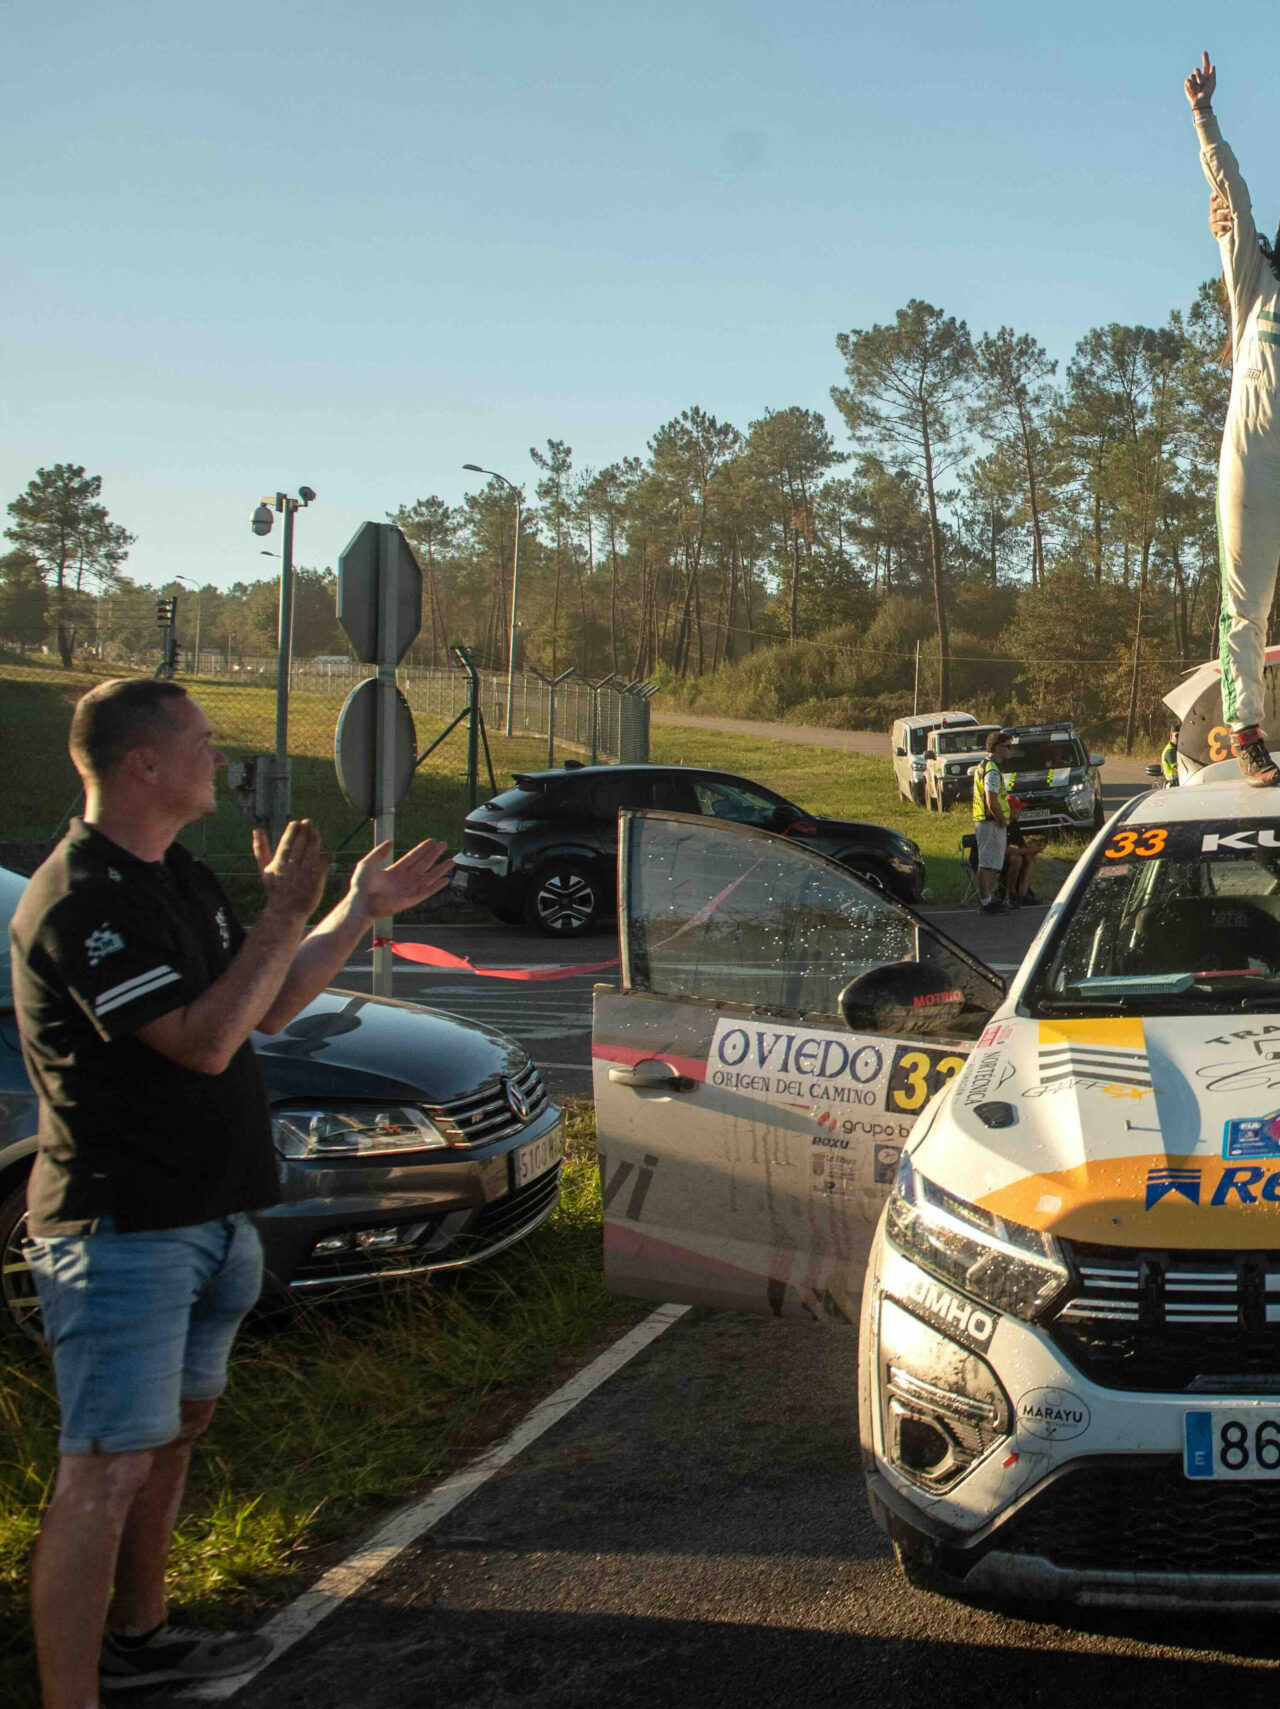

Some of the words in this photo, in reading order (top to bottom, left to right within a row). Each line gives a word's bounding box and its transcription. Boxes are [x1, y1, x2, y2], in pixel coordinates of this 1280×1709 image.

[1208, 726, 1237, 762] 3
[1104, 829, 1168, 858] 33
[912, 990, 961, 1008] MOTRIO
[718, 1028, 883, 1084] OVIEDO
[712, 1070, 771, 1092] ORIGEN
[776, 1079, 804, 1098] DEL
[809, 1083, 877, 1106] CAMINO
[842, 1120, 894, 1137] grupo
[905, 1280, 994, 1341] UMHO
[1022, 1404, 1083, 1423] MARAYU
